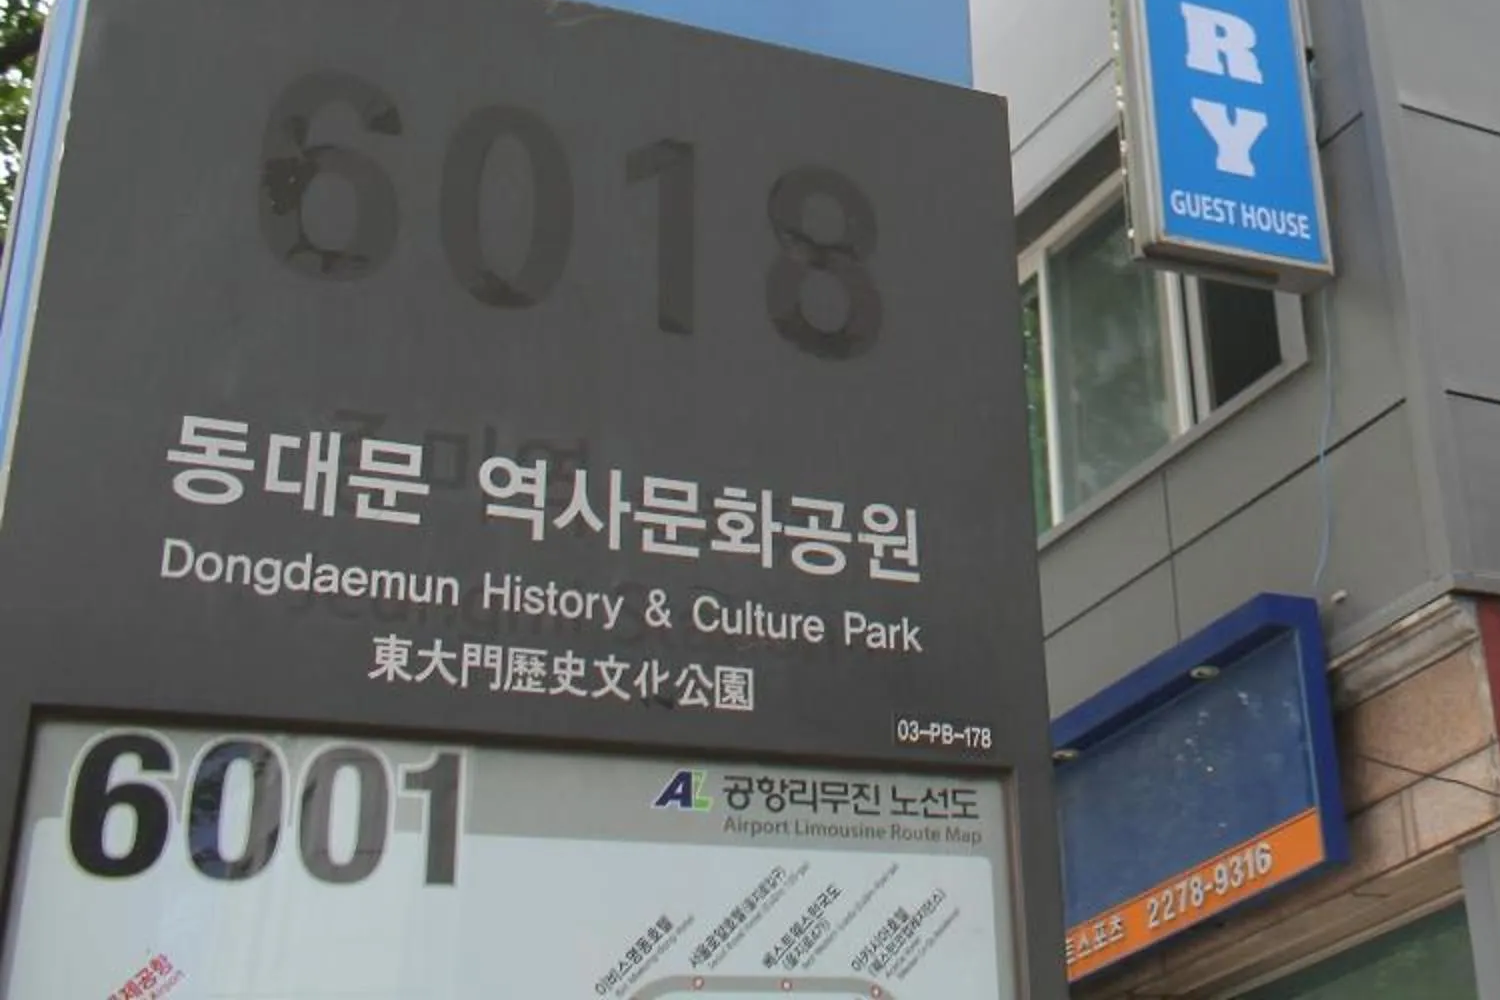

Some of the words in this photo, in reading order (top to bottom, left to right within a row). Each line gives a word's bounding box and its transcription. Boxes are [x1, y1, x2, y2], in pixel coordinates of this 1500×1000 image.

[259, 68, 884, 362] 6018
[1170, 189, 1237, 226] GUEST
[1241, 204, 1311, 239] HOUSE
[166, 414, 431, 525] 동대문
[477, 454, 923, 584] 역사문화공원
[160, 537, 460, 606] Dongdaemun
[482, 571, 625, 629] History
[644, 590, 673, 629] &
[692, 597, 826, 646] Culture
[843, 610, 924, 655] Park
[896, 718, 994, 750] 03-PB-178
[68, 731, 464, 886] 6001
[723, 773, 881, 817] 공항리무진
[890, 786, 980, 819] 노선도
[724, 817, 790, 839] Airport
[794, 819, 887, 840] Limousine
[891, 824, 940, 843] Route
[945, 827, 982, 846] Map
[1146, 842, 1273, 928] 2278-9316
